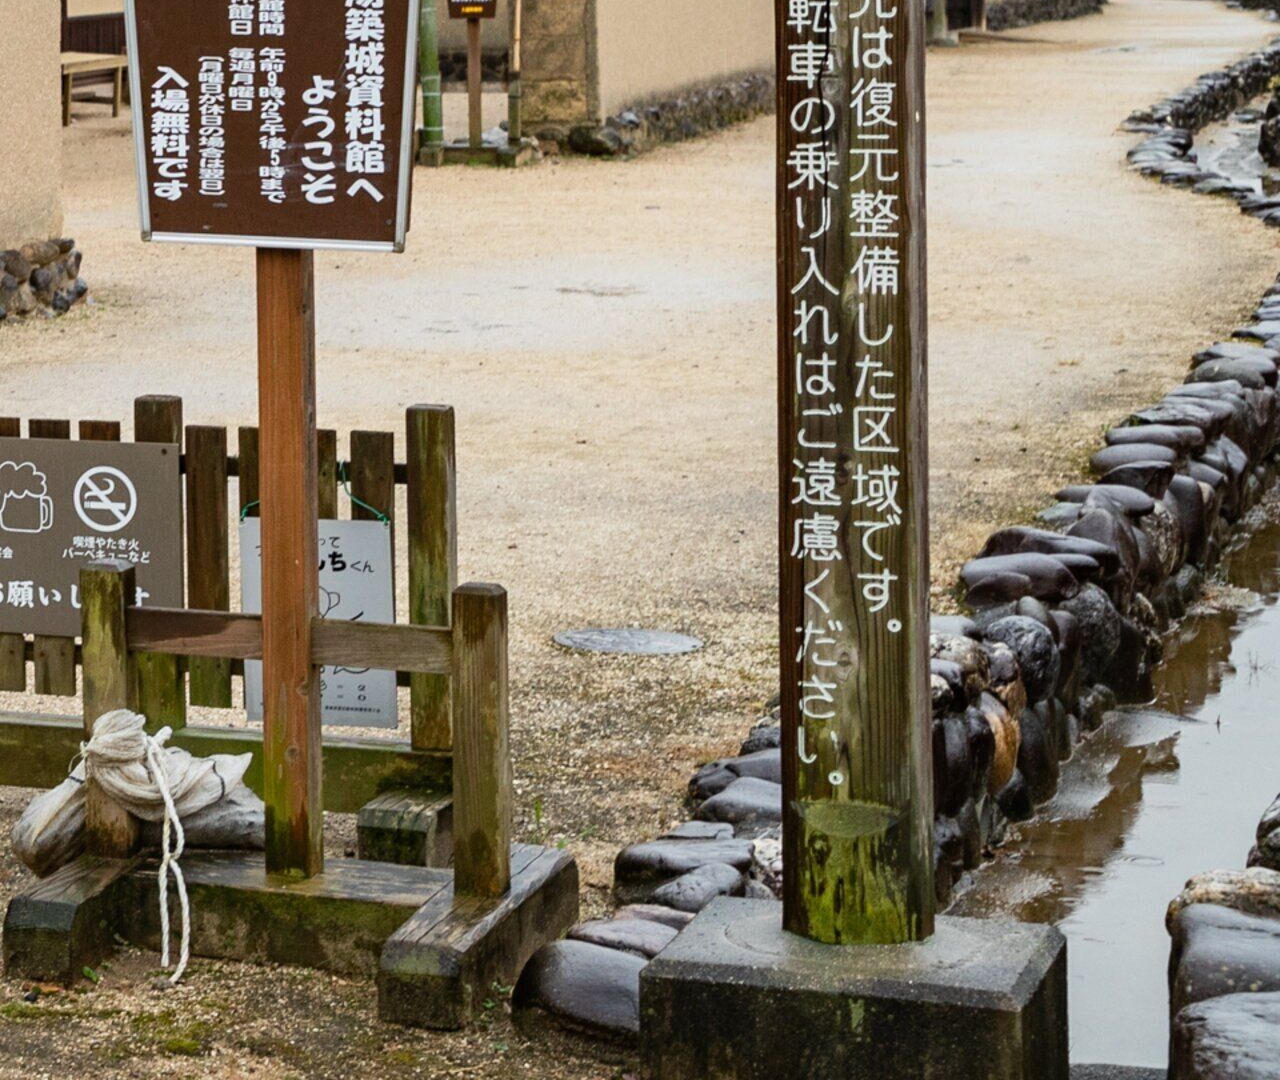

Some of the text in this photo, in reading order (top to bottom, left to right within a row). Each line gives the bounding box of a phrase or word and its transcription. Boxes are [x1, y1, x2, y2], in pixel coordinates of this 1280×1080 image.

[150, 65, 190, 202] 入場無料です
[300, 75, 337, 205] ようこそ
[72, 535, 140, 551] 喫煙やたき火
